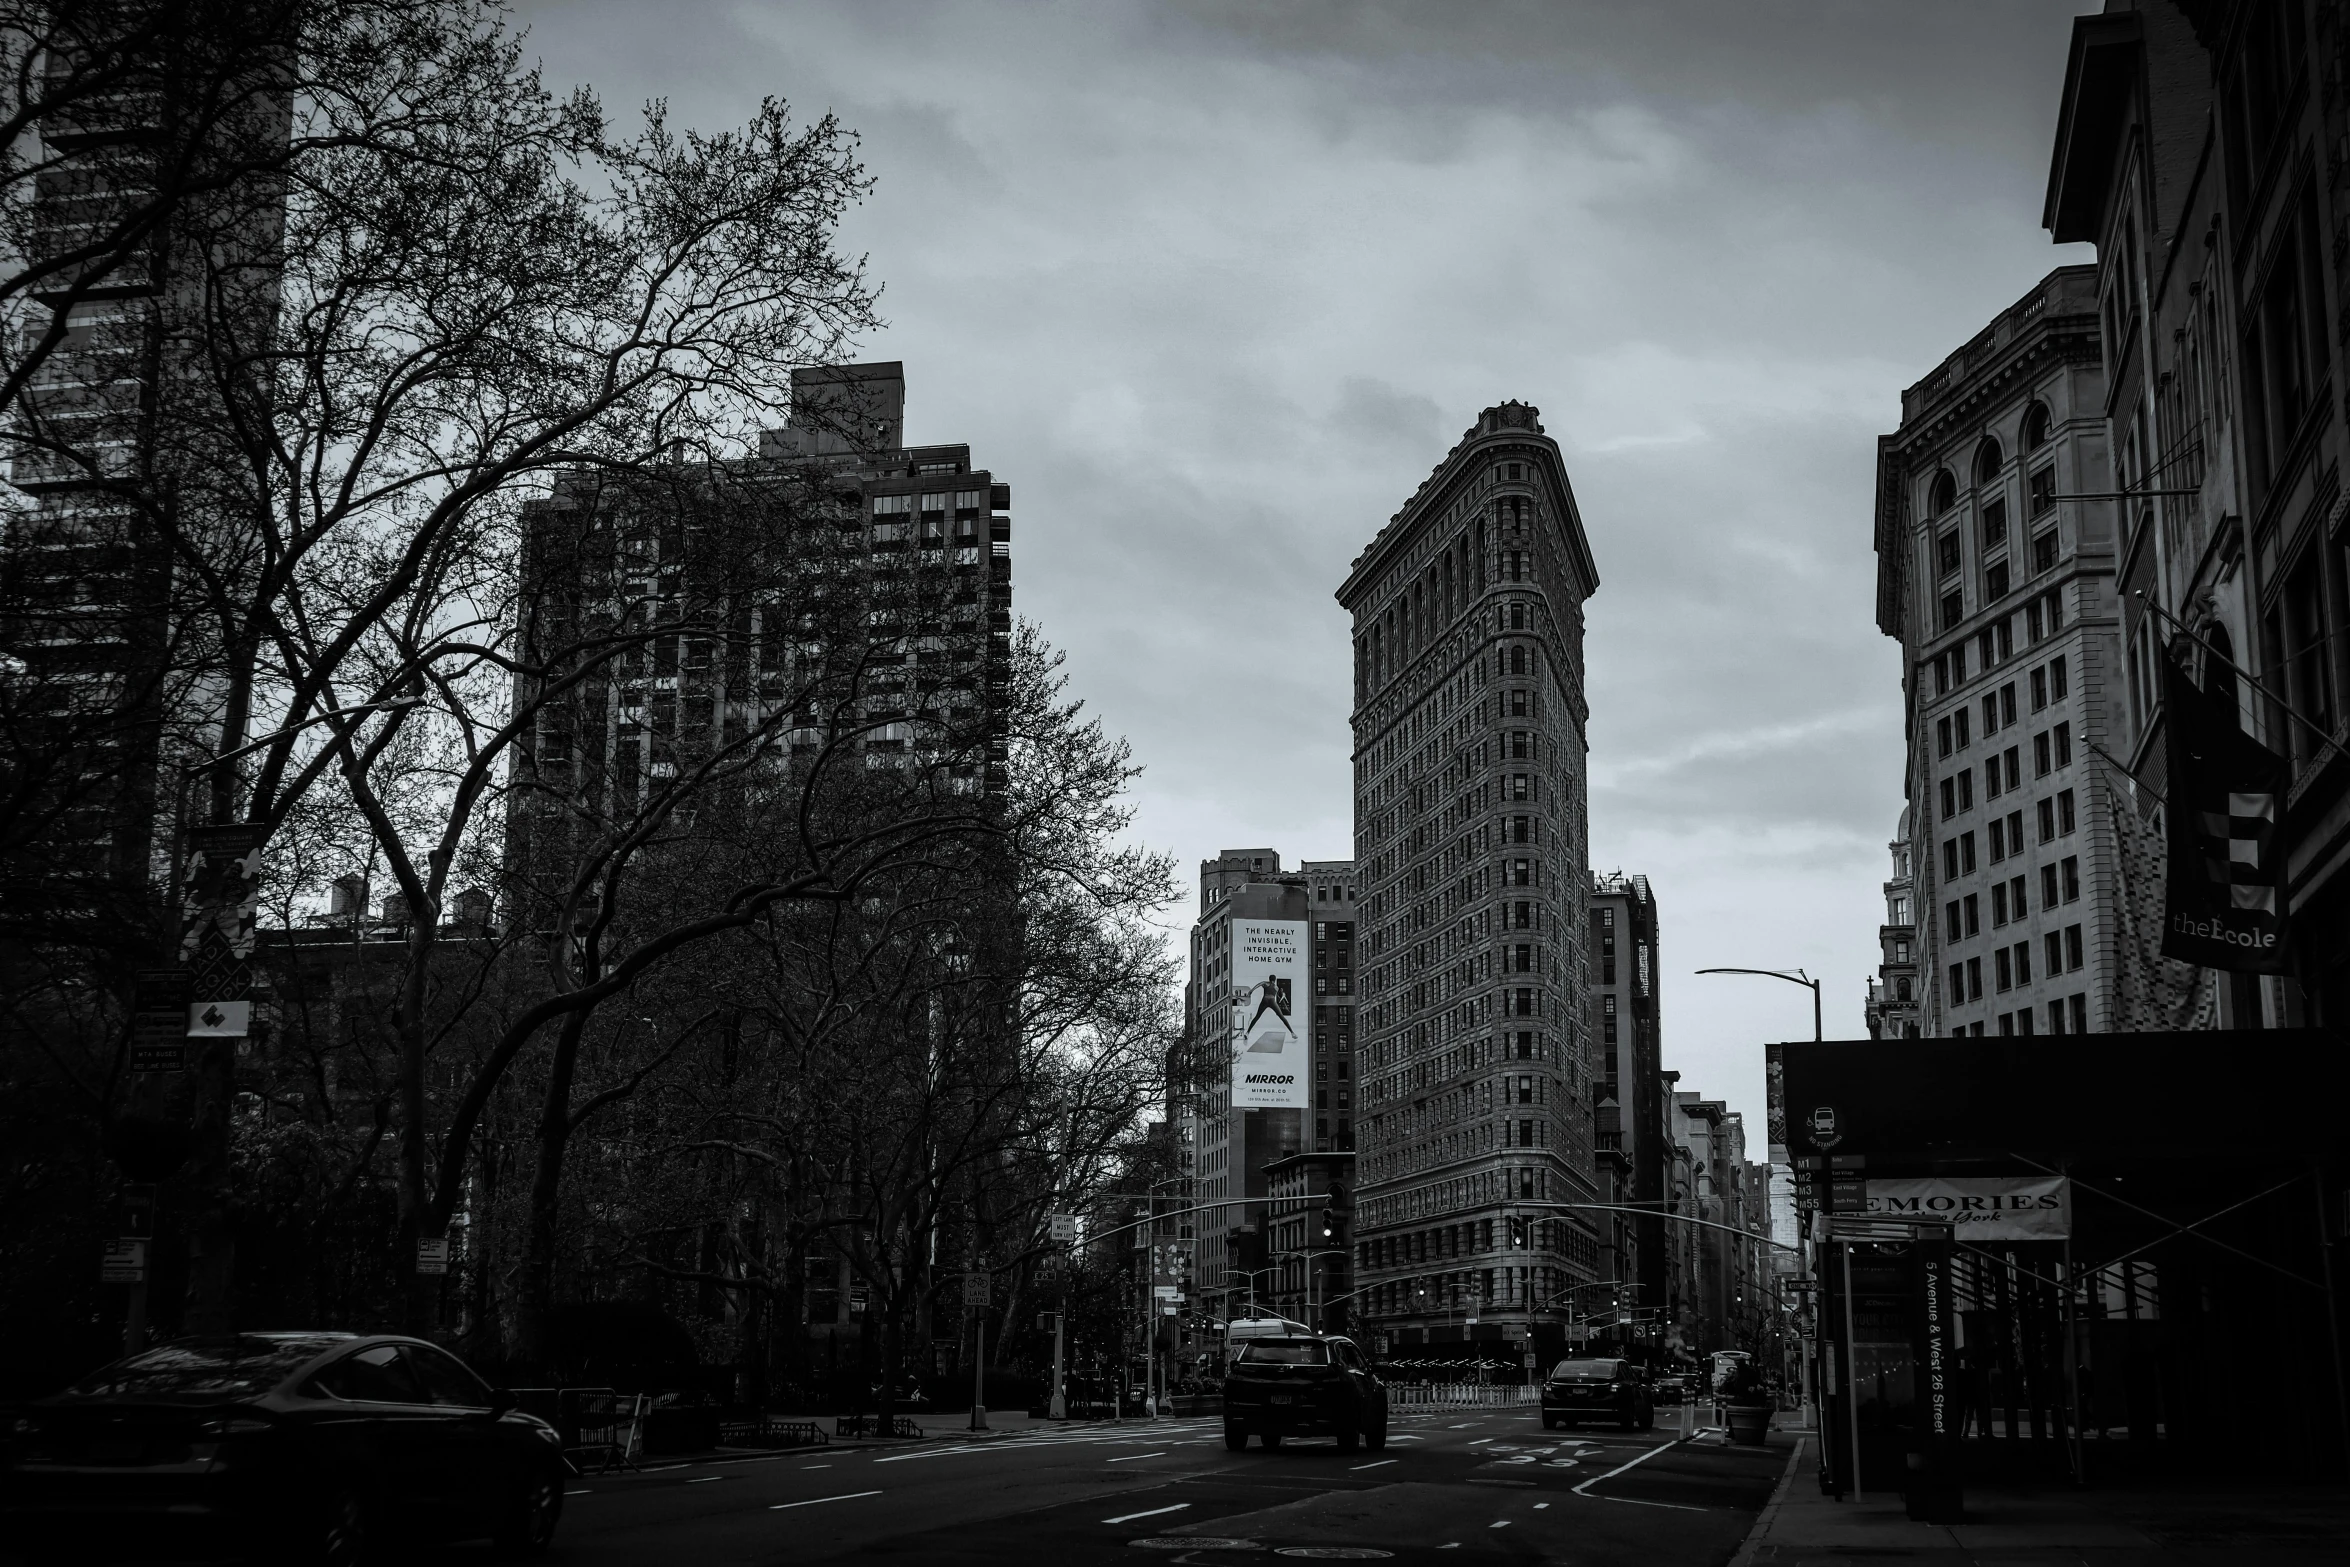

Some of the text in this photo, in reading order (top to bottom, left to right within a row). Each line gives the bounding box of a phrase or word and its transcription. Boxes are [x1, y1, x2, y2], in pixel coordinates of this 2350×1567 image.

[1248, 937, 1292, 945] INVISIBLE,
[1243, 946, 1296, 954] INTERACTIVE
[1248, 955, 1272, 963] HOME
[1245, 1074, 1294, 1085] MIRROR
[1808, 1134, 1843, 1148] NO STANDING
[1798, 1158, 1810, 1168] M1
[1798, 1173, 1812, 1183] M2
[1799, 1185, 1812, 1195] M3
[1799, 1198, 1819, 1209] M55
[1866, 1194, 2059, 1212] EMORIES
[1953, 1211, 2001, 1224] York
[1853, 1312, 1880, 1326] YOUR
[1926, 1262, 1946, 1434] 5 Avenue & West 26 Street
[1494, 1455, 1580, 1468] 23
